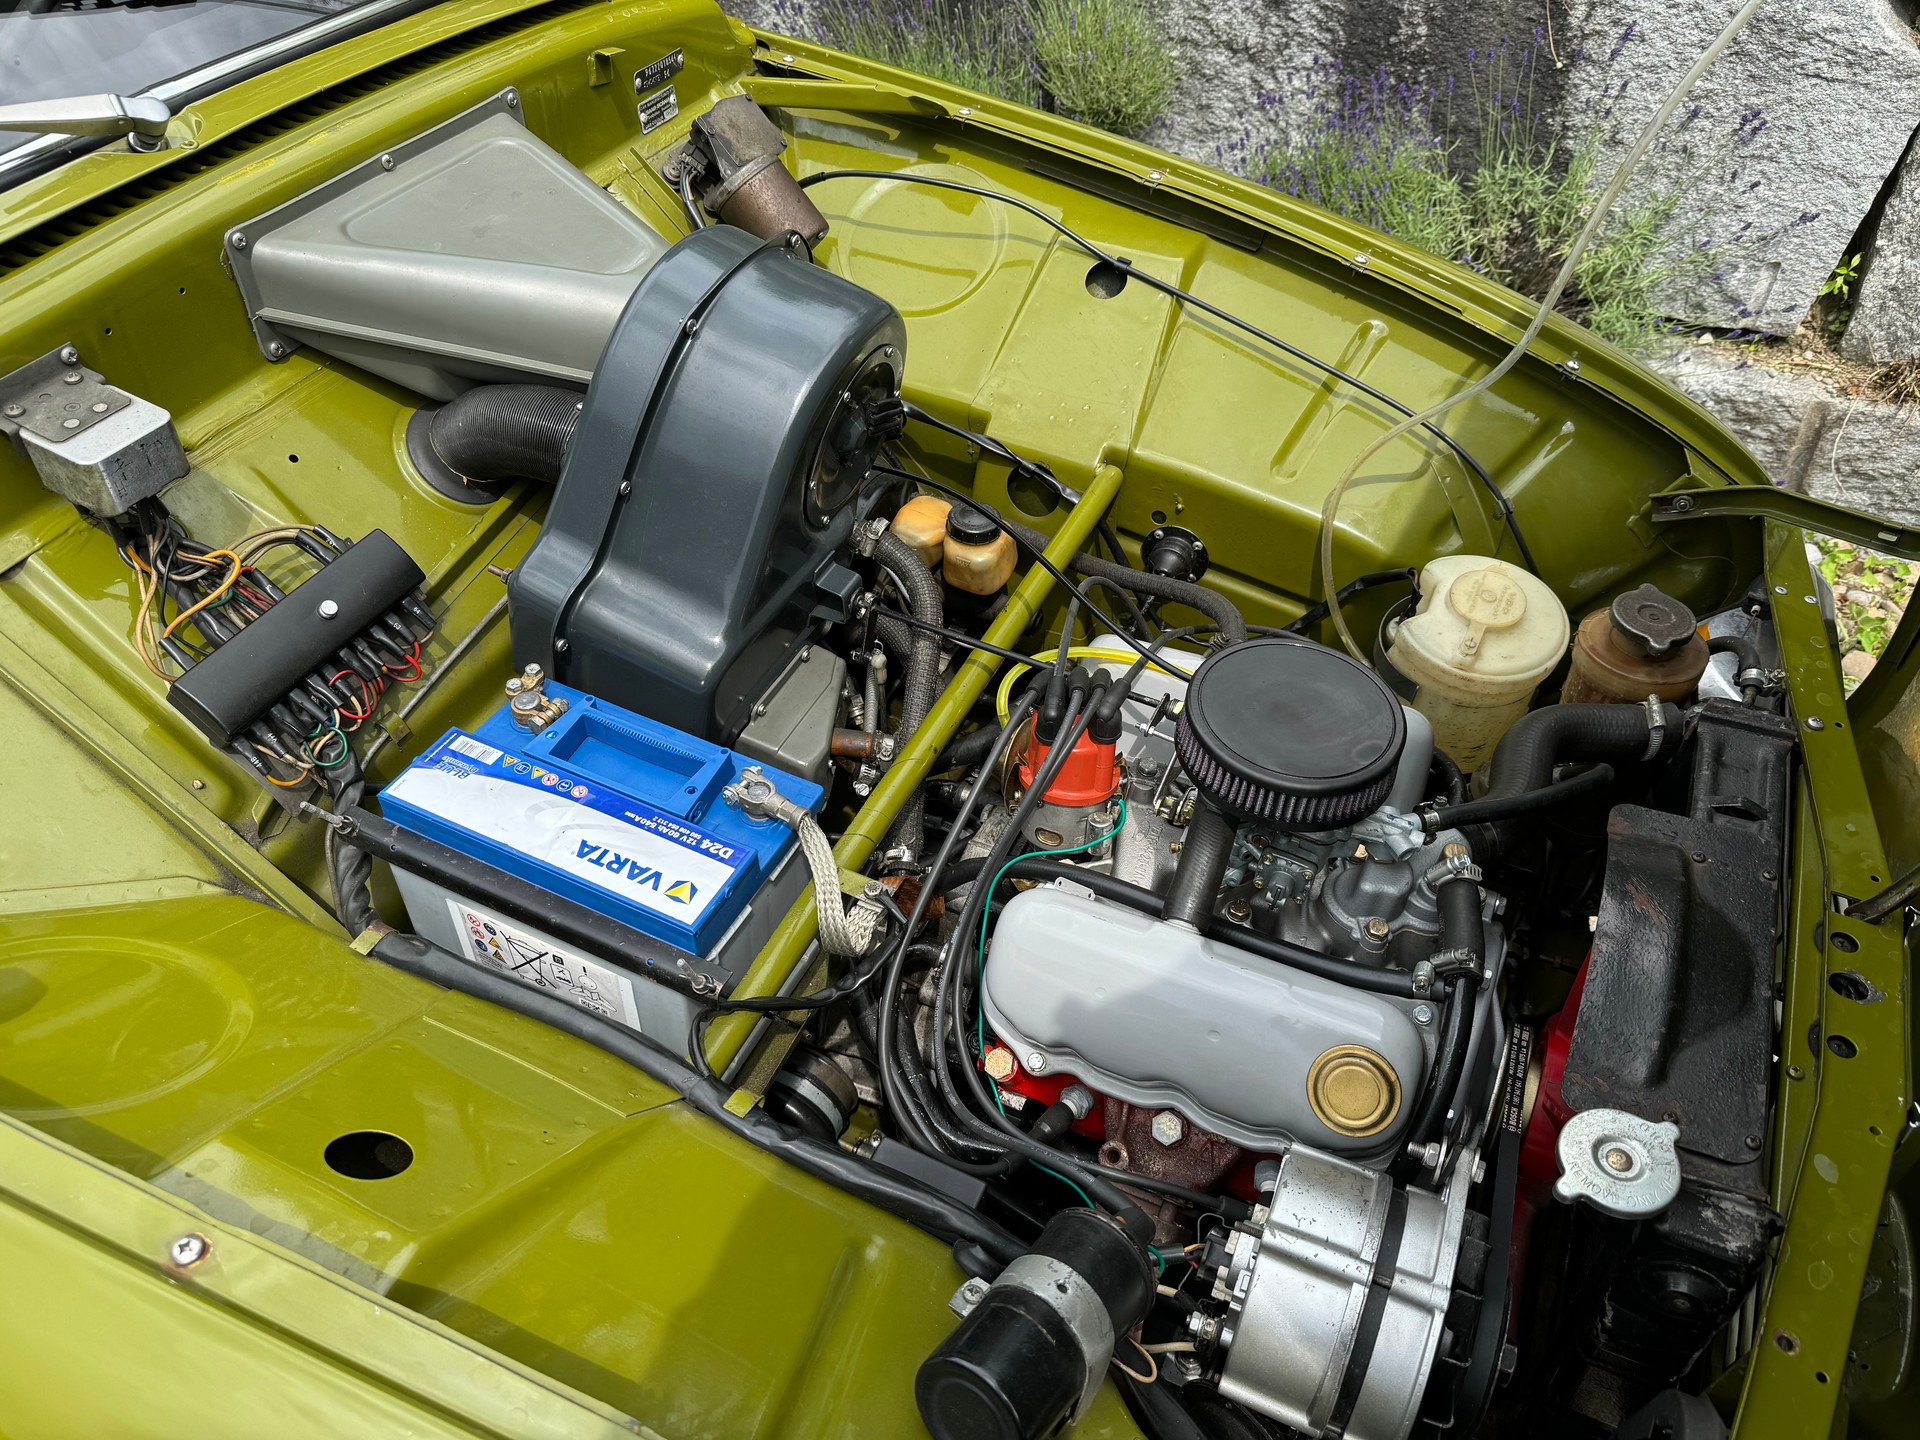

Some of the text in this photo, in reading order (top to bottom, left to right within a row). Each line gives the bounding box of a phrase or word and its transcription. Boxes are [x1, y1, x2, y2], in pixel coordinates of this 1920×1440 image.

[250, 756, 264, 769] 44B
[433, 761, 471, 780] BLUE
[657, 824, 680, 839] 60Ah
[681, 833, 697, 845] 12V
[700, 838, 734, 859] D24
[576, 839, 663, 892] VARTA
[1508, 1106, 1518, 1126] BOSCH
